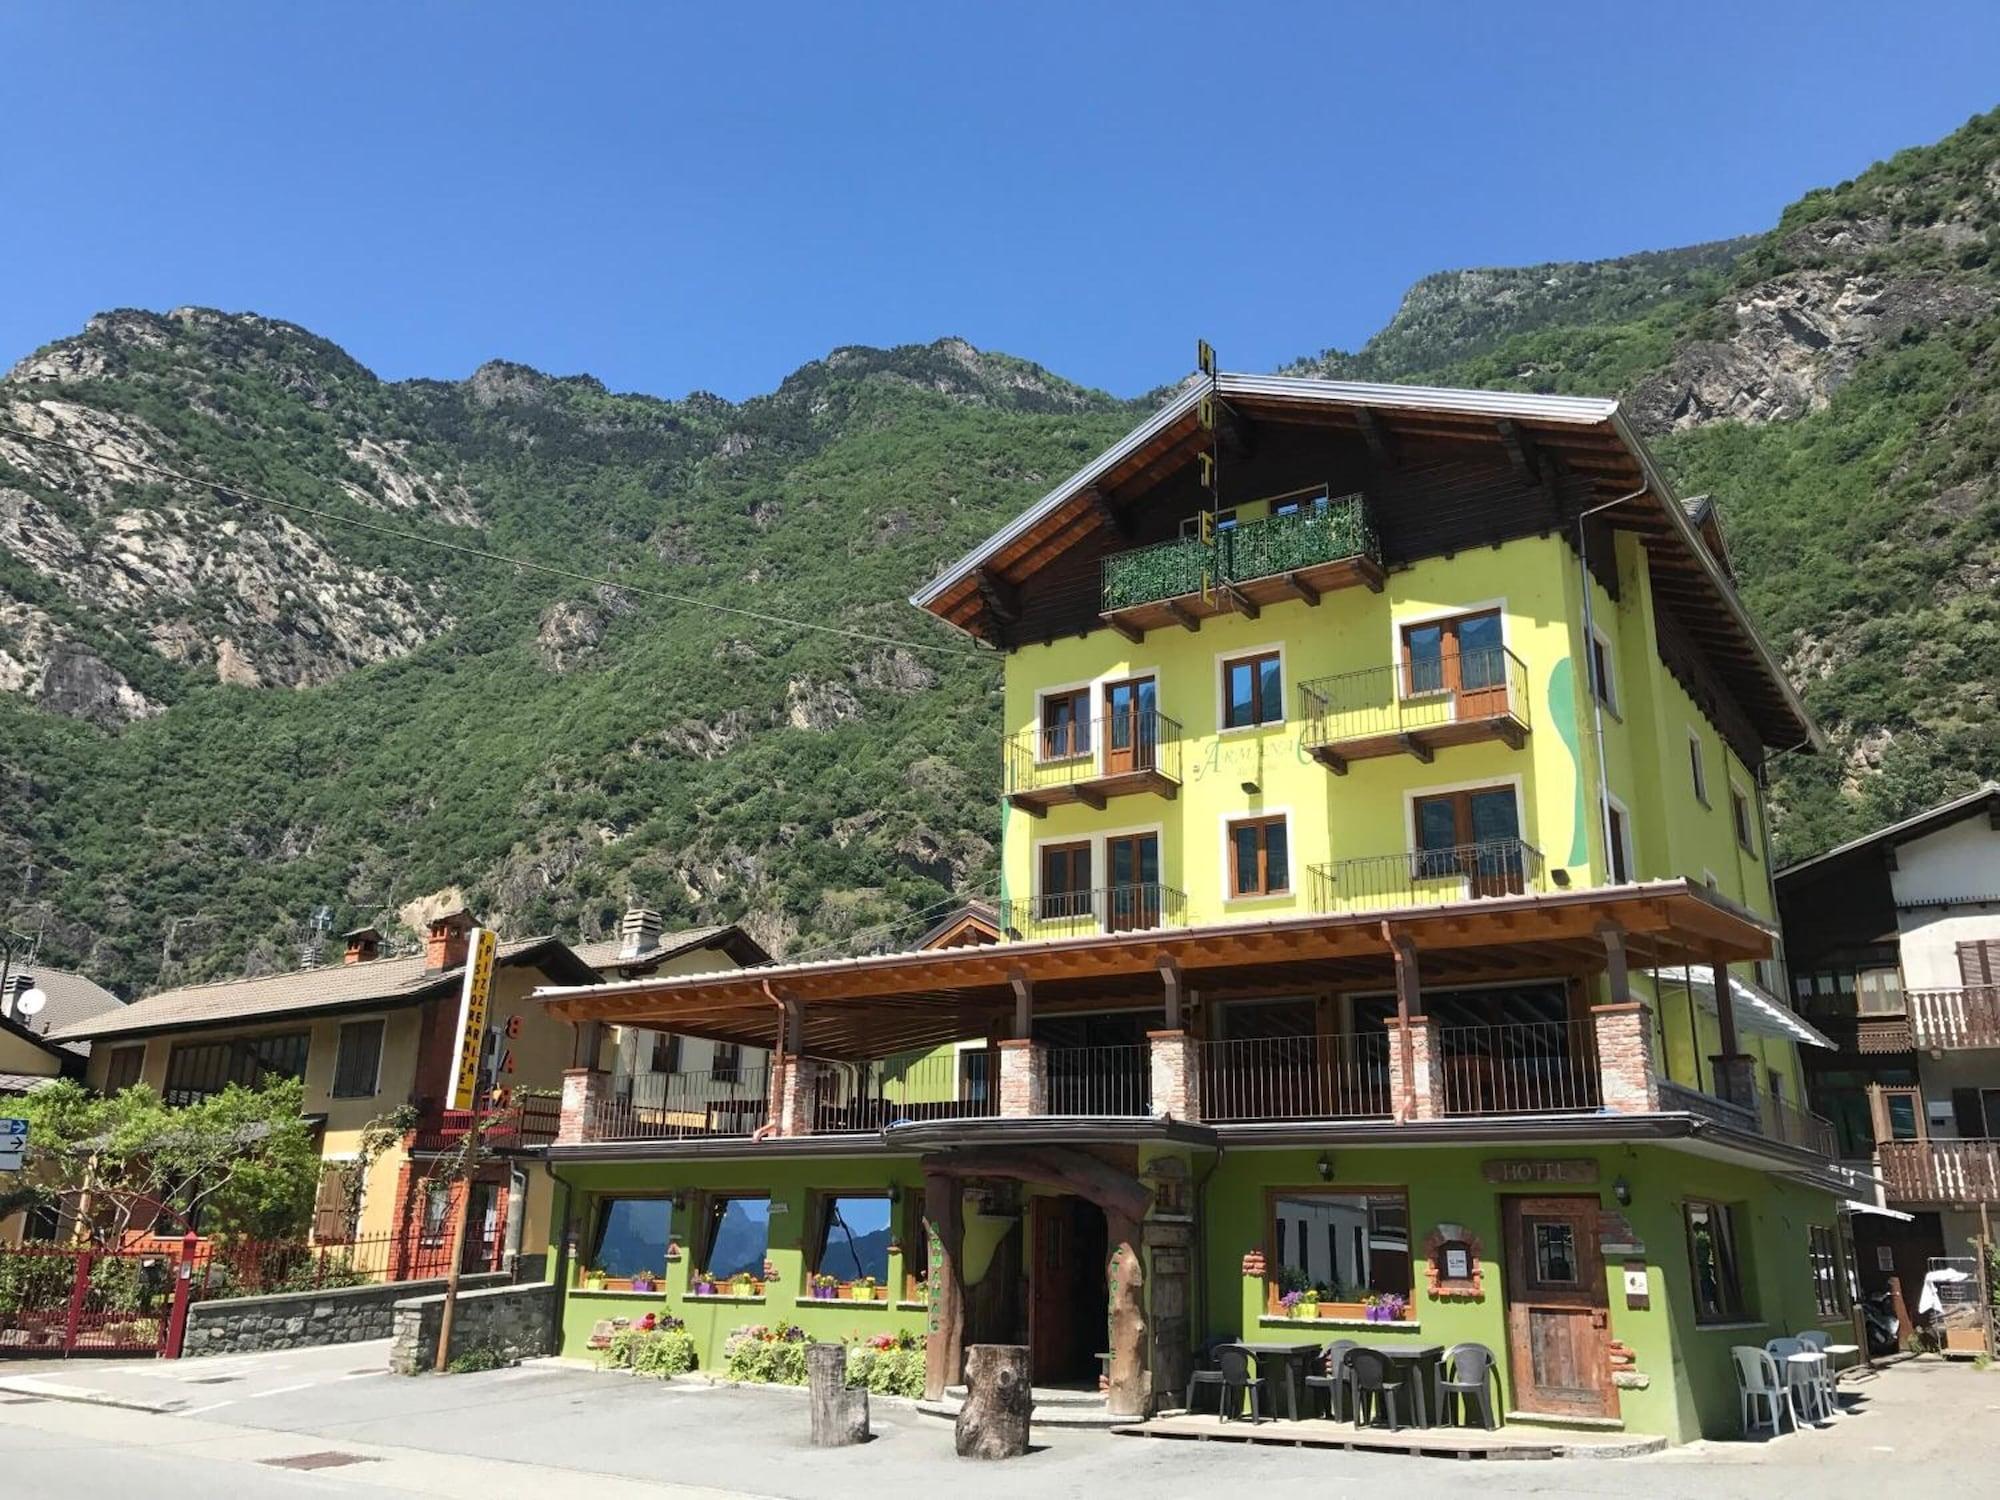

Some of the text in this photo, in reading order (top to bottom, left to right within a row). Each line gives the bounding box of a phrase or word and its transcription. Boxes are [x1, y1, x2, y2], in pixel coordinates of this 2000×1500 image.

[1198, 338, 1217, 607] HOTEL
[458, 934, 486, 1085] RISTORANTE
[467, 944, 492, 1076] PIZZERIA
[495, 1014, 526, 1109] BAR
[1503, 1162, 1567, 1181] HOTEL
